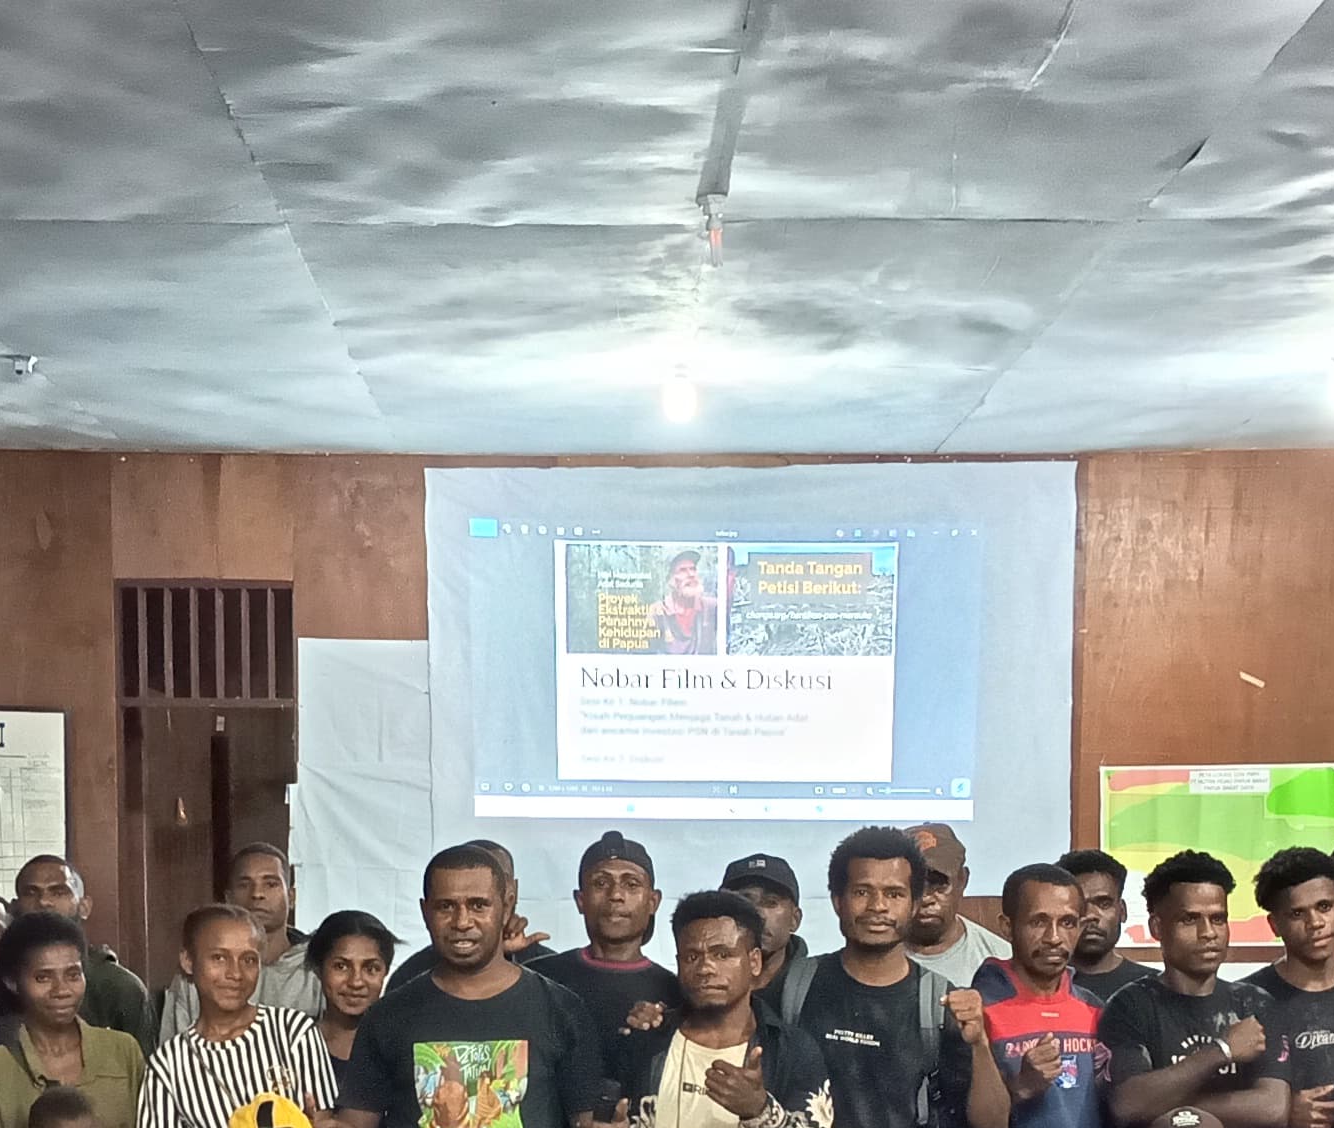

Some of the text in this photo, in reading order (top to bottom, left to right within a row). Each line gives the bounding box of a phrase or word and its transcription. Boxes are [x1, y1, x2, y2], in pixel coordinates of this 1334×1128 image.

[757, 561, 863, 578] Tanda Tangan
[758, 581, 862, 595] Petisi Berikut:
[598, 593, 638, 607] Proyek
[599, 615, 656, 630] Punahnya
[599, 627, 661, 641] Kehidupan
[598, 638, 649, 652] di Papua
[581, 667, 832, 690] Nobar Film & Diskusi
[1063, 1037, 1097, 1054] HOCK
